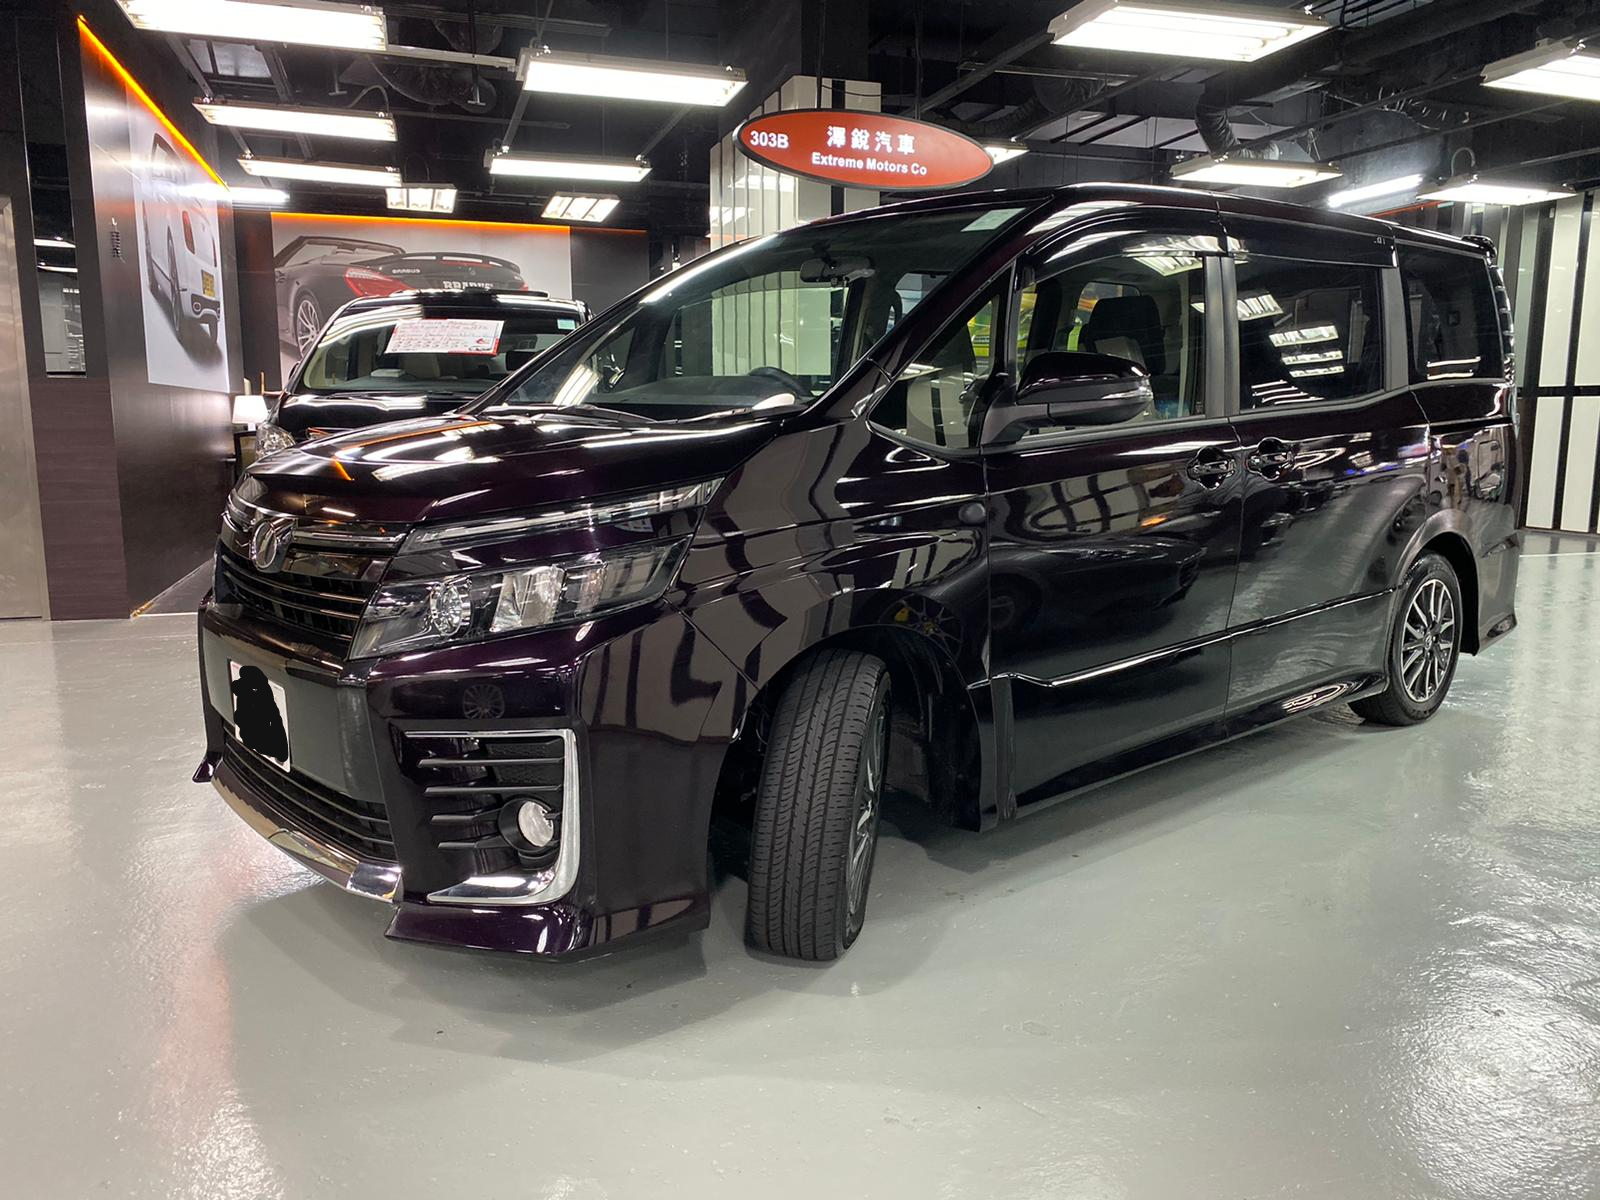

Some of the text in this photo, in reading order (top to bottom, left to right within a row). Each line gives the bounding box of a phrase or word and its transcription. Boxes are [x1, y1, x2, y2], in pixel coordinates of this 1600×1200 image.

[750, 131, 789, 149] 303B
[812, 152, 927, 175] Extreme Motors Co
